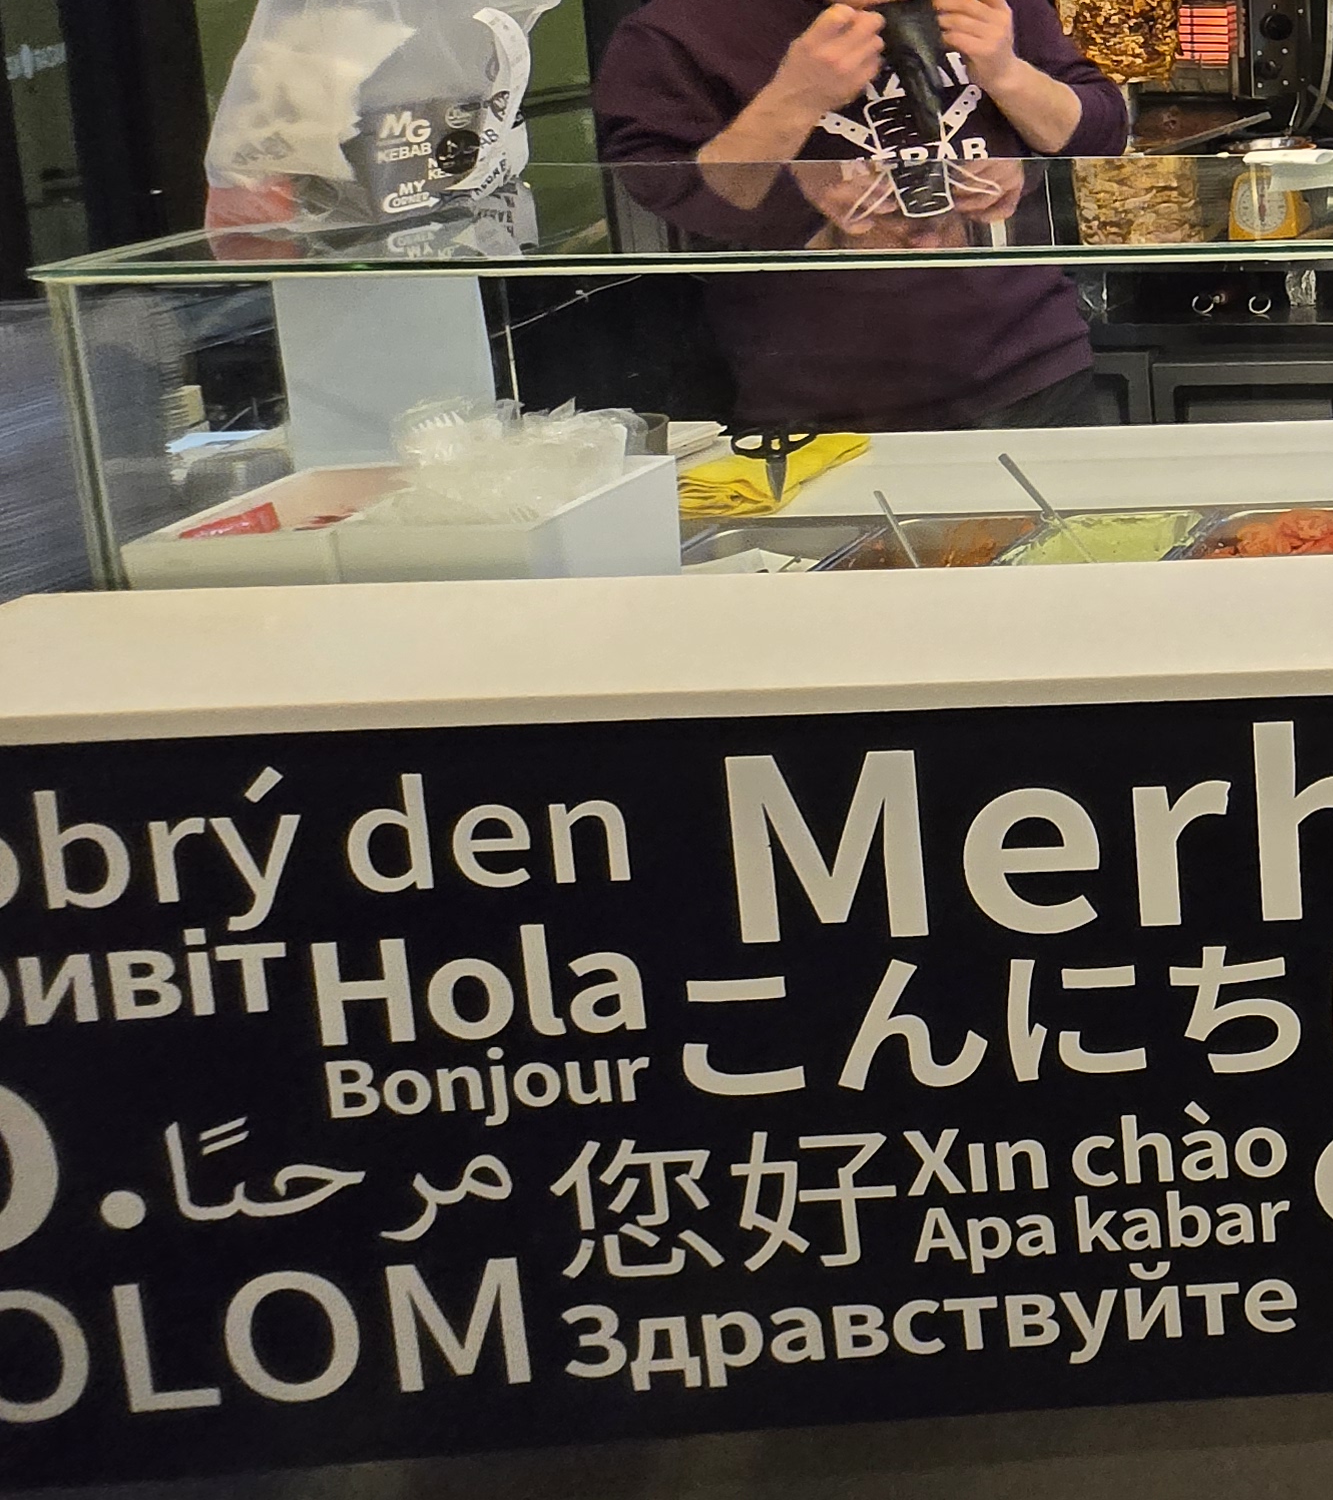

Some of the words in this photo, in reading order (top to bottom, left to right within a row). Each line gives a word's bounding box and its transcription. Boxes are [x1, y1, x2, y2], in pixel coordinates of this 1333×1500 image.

[377, 142, 432, 164] KEBAB
[379, 111, 431, 143] MG
[399, 180, 425, 195] MY
[346, 773, 632, 893] den
[0, 928, 287, 1026] ивіт
[311, 923, 648, 1047] Hola
[324, 1047, 650, 1126] Bonjour
[1071, 1102, 1288, 1186] chào
[549, 1129, 897, 1279] 您好
[914, 1207, 1057, 1274] Apa
[1077, 1192, 1291, 1254] kabar
[562, 1260, 1298, 1392] Здравствуйте
